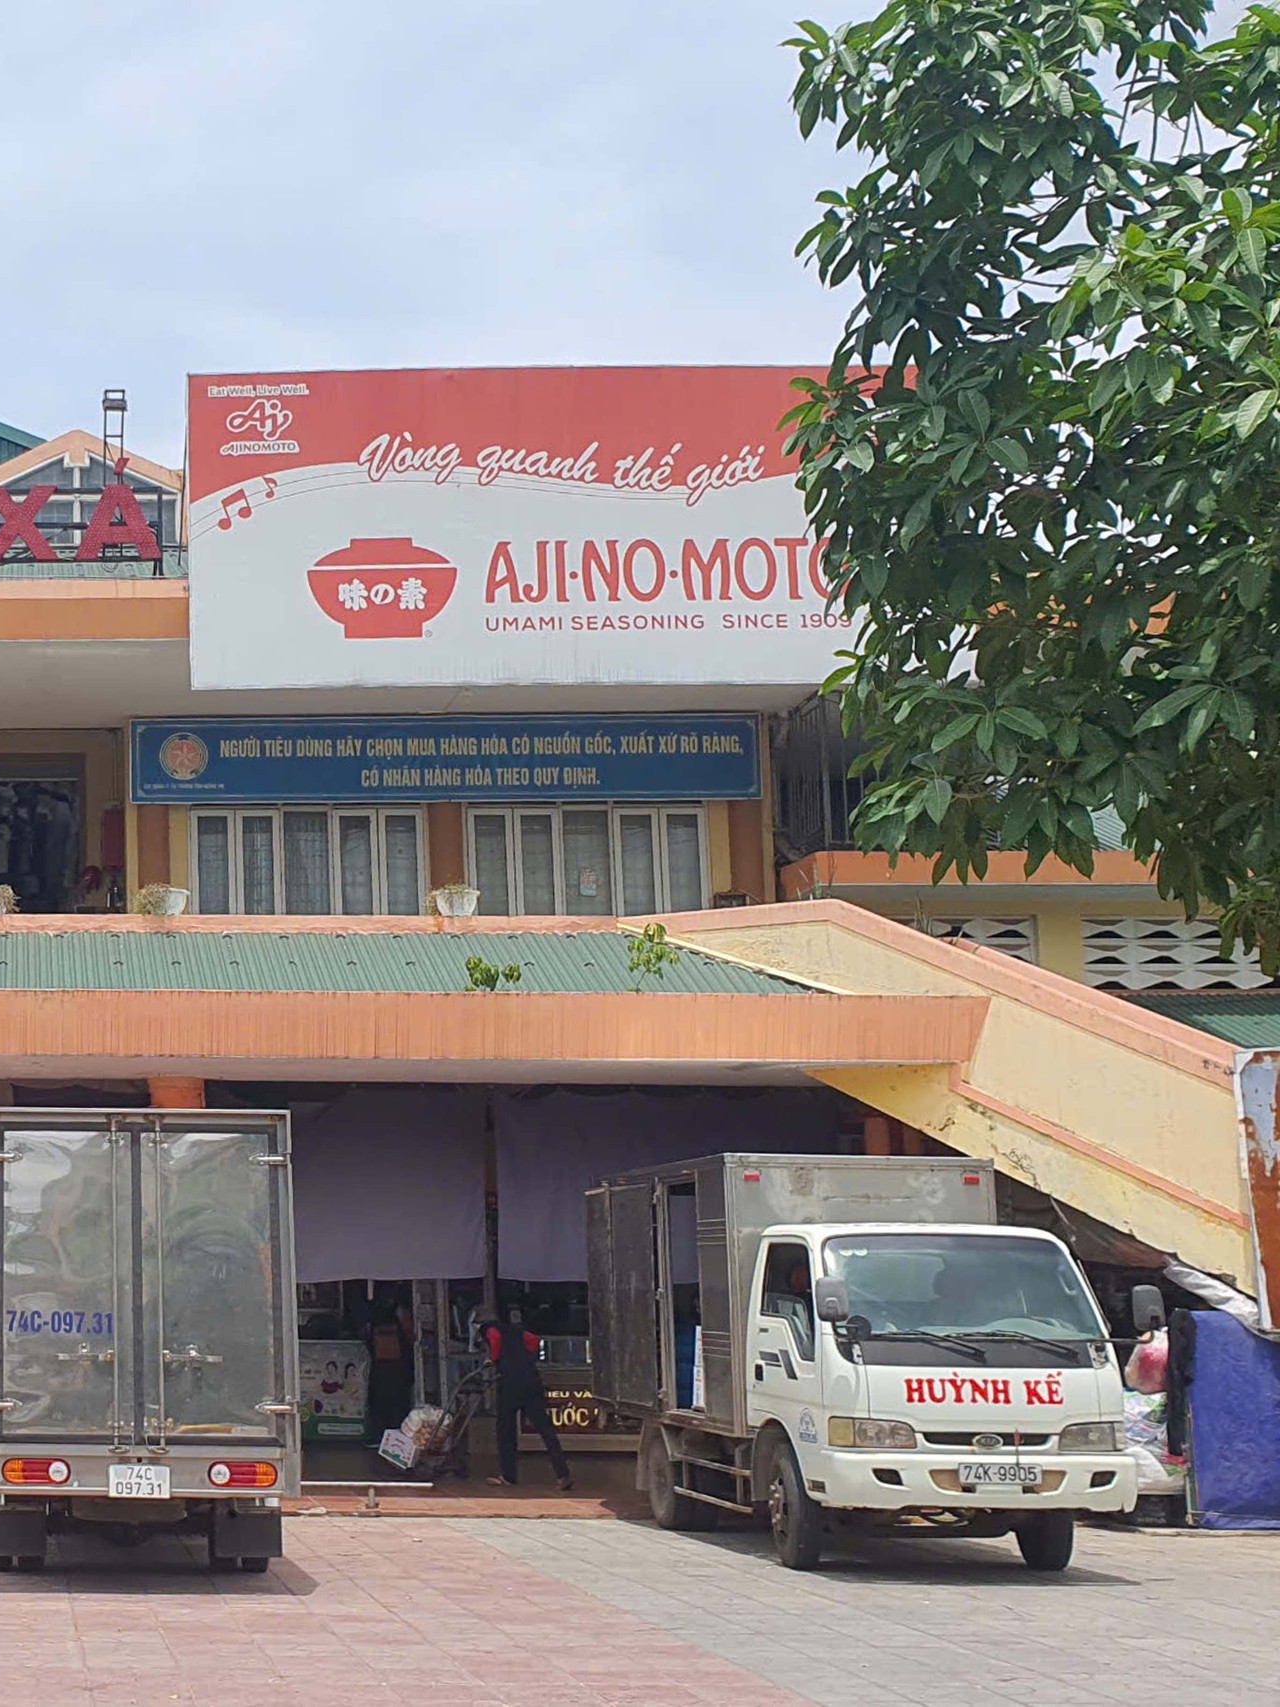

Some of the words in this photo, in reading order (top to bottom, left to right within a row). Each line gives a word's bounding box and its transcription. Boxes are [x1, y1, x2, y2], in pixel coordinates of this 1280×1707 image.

[208, 386, 227, 396] Eat
[228, 386, 255, 397] Well,
[257, 385, 280, 395] Live
[281, 384, 309, 395] Well.
[221, 441, 297, 454] AJINOMOTO
[358, 431, 462, 484] Vòng
[476, 441, 599, 485] quanh
[613, 442, 683, 491] thế
[686, 444, 766, 507] giới
[337, 577, 428, 611] 味の素
[485, 614, 563, 631] UMAMI
[571, 613, 705, 631] SEASONING
[722, 612, 788, 629] SINCE
[800, 612, 852, 629] 1909
[220, 735, 260, 758] NGƯỜI
[264, 736, 292, 757] TIÊU
[297, 735, 333, 757] DÙNG
[336, 735, 362, 757] HÃY
[366, 738, 403, 760] CHỌN
[407, 738, 437, 756] MUA
[440, 734, 478, 756] HÀNG
[481, 733, 508, 755] HÓA
[512, 733, 529, 755] CÓ
[620, 730, 655, 754] XUẤT
[361, 765, 379, 787] CÓ
[383, 765, 420, 787] NHÃN
[424, 765, 461, 786] HÀNG
[465, 764, 492, 786] HÓA
[496, 767, 529, 785] THEO
[534, 767, 560, 786] QUY
[6, 1310, 113, 1334] 74C-097.31
[904, 1372, 1012, 1405] HUỲNH
[1023, 1371, 1064, 1406] KẾ
[127, 1467, 153, 1481] 74C
[963, 1464, 1038, 1482] 74K-9905
[116, 1482, 163, 1496] 097.31
